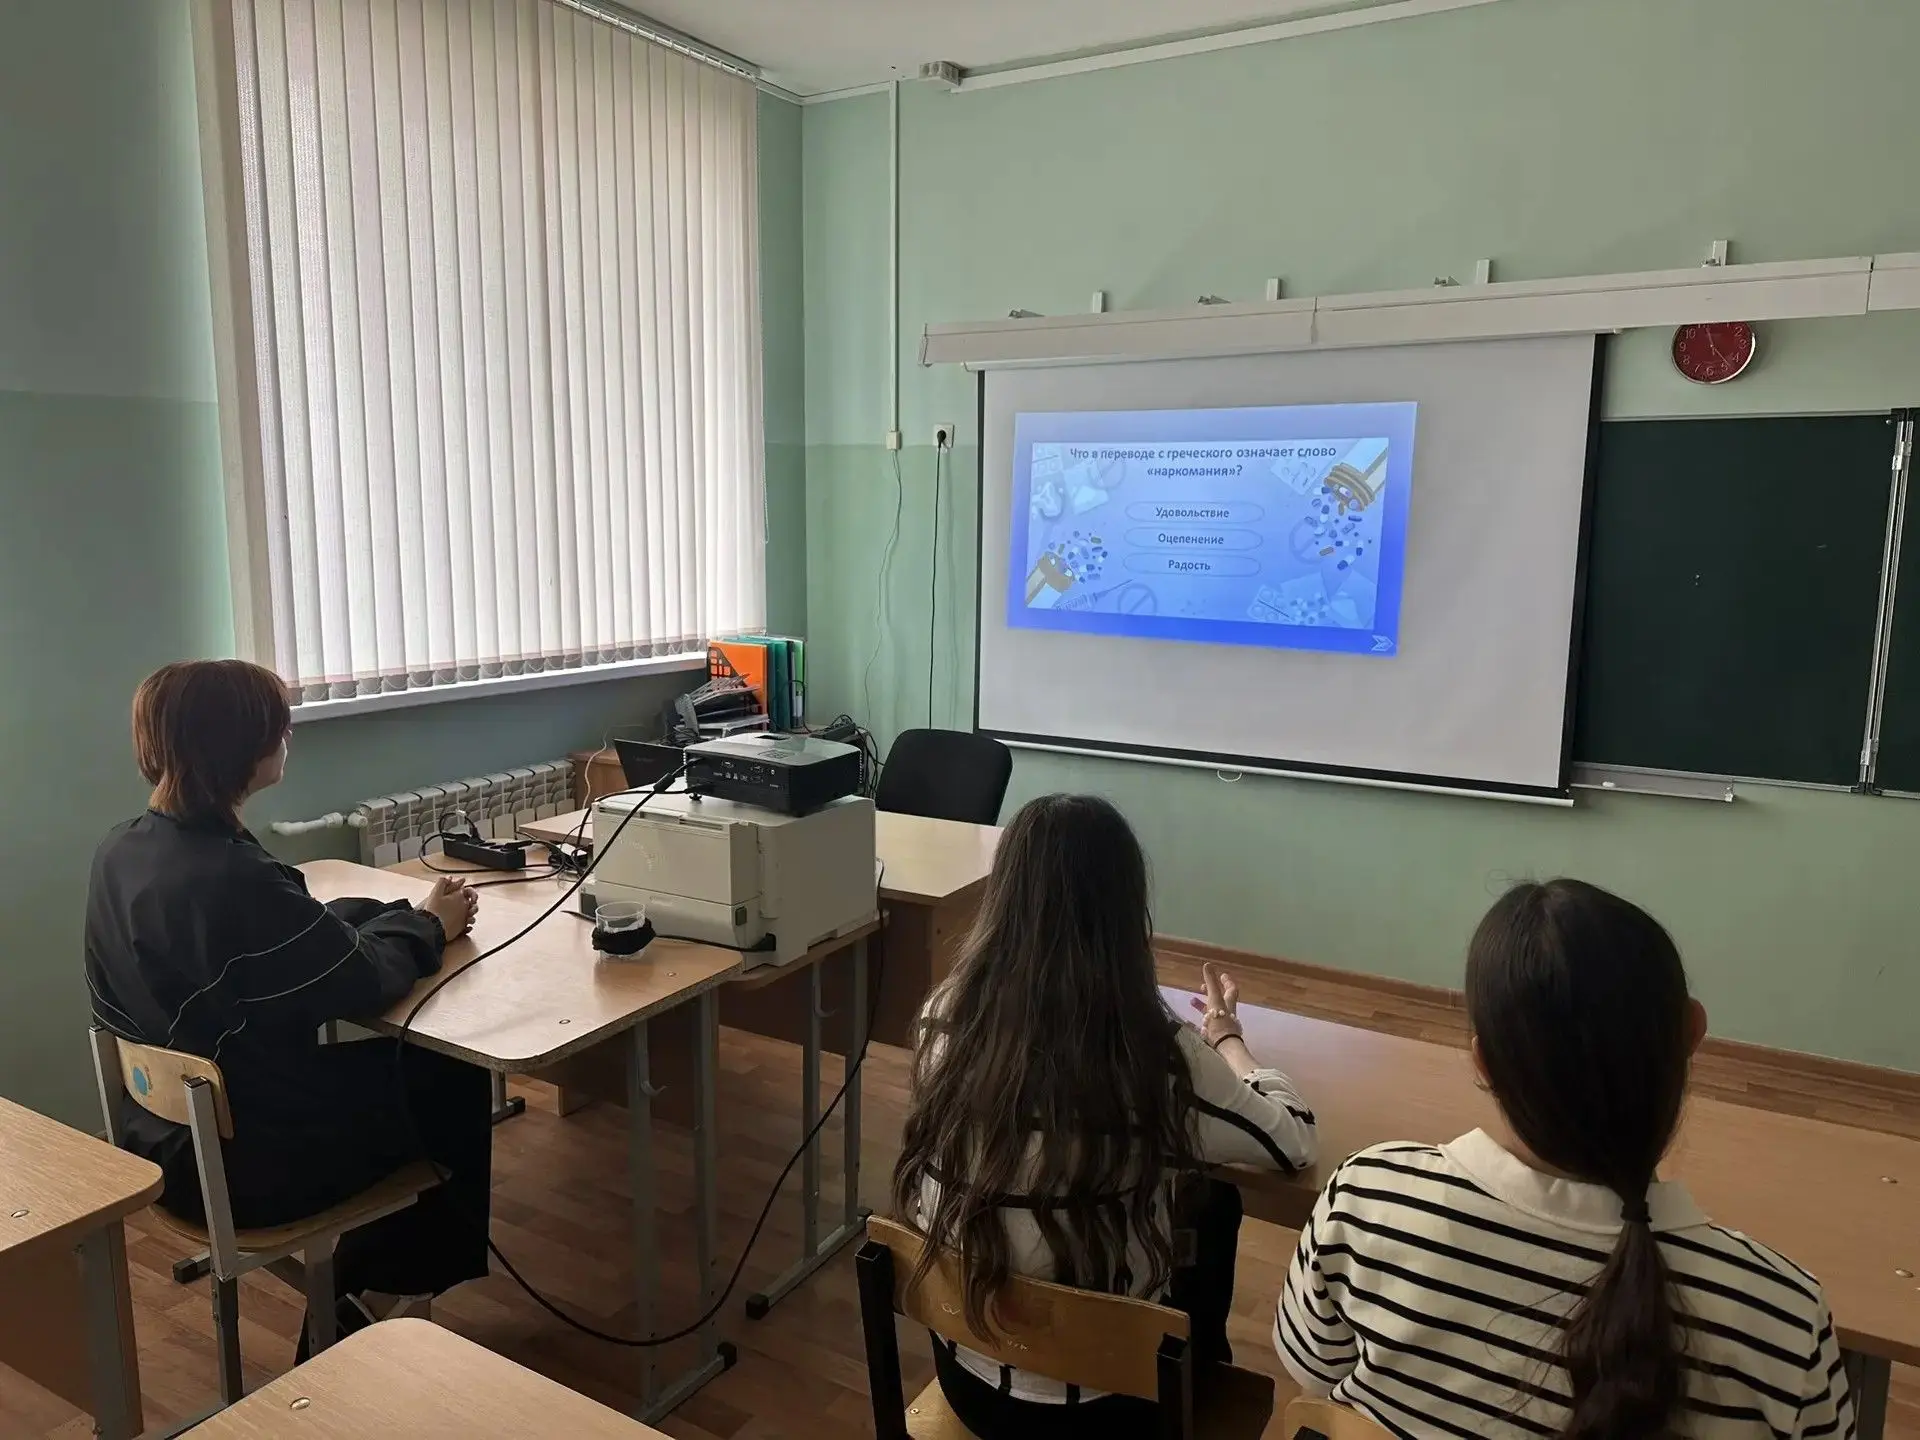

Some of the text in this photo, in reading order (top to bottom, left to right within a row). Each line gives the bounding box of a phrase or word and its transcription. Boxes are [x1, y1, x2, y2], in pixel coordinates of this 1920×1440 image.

[1685, 328, 1696, 339] 10
[1734, 326, 1744, 336] 2
[1679, 341, 1687, 352] 9
[1738, 339, 1747, 349] 3
[1682, 355, 1690, 365] 8
[1732, 352, 1740, 362] 4
[1694, 363, 1701, 373] 7
[1706, 366, 1715, 376] 6
[1721, 362, 1728, 372] 5
[1070, 447, 1337, 461] Что в переводе с греческого означает слово
[1147, 464, 1243, 478] «наркомания»?
[1155, 507, 1230, 519] Удовольствие
[1158, 533, 1225, 545] Оцепенение
[1168, 559, 1211, 572] Радость
